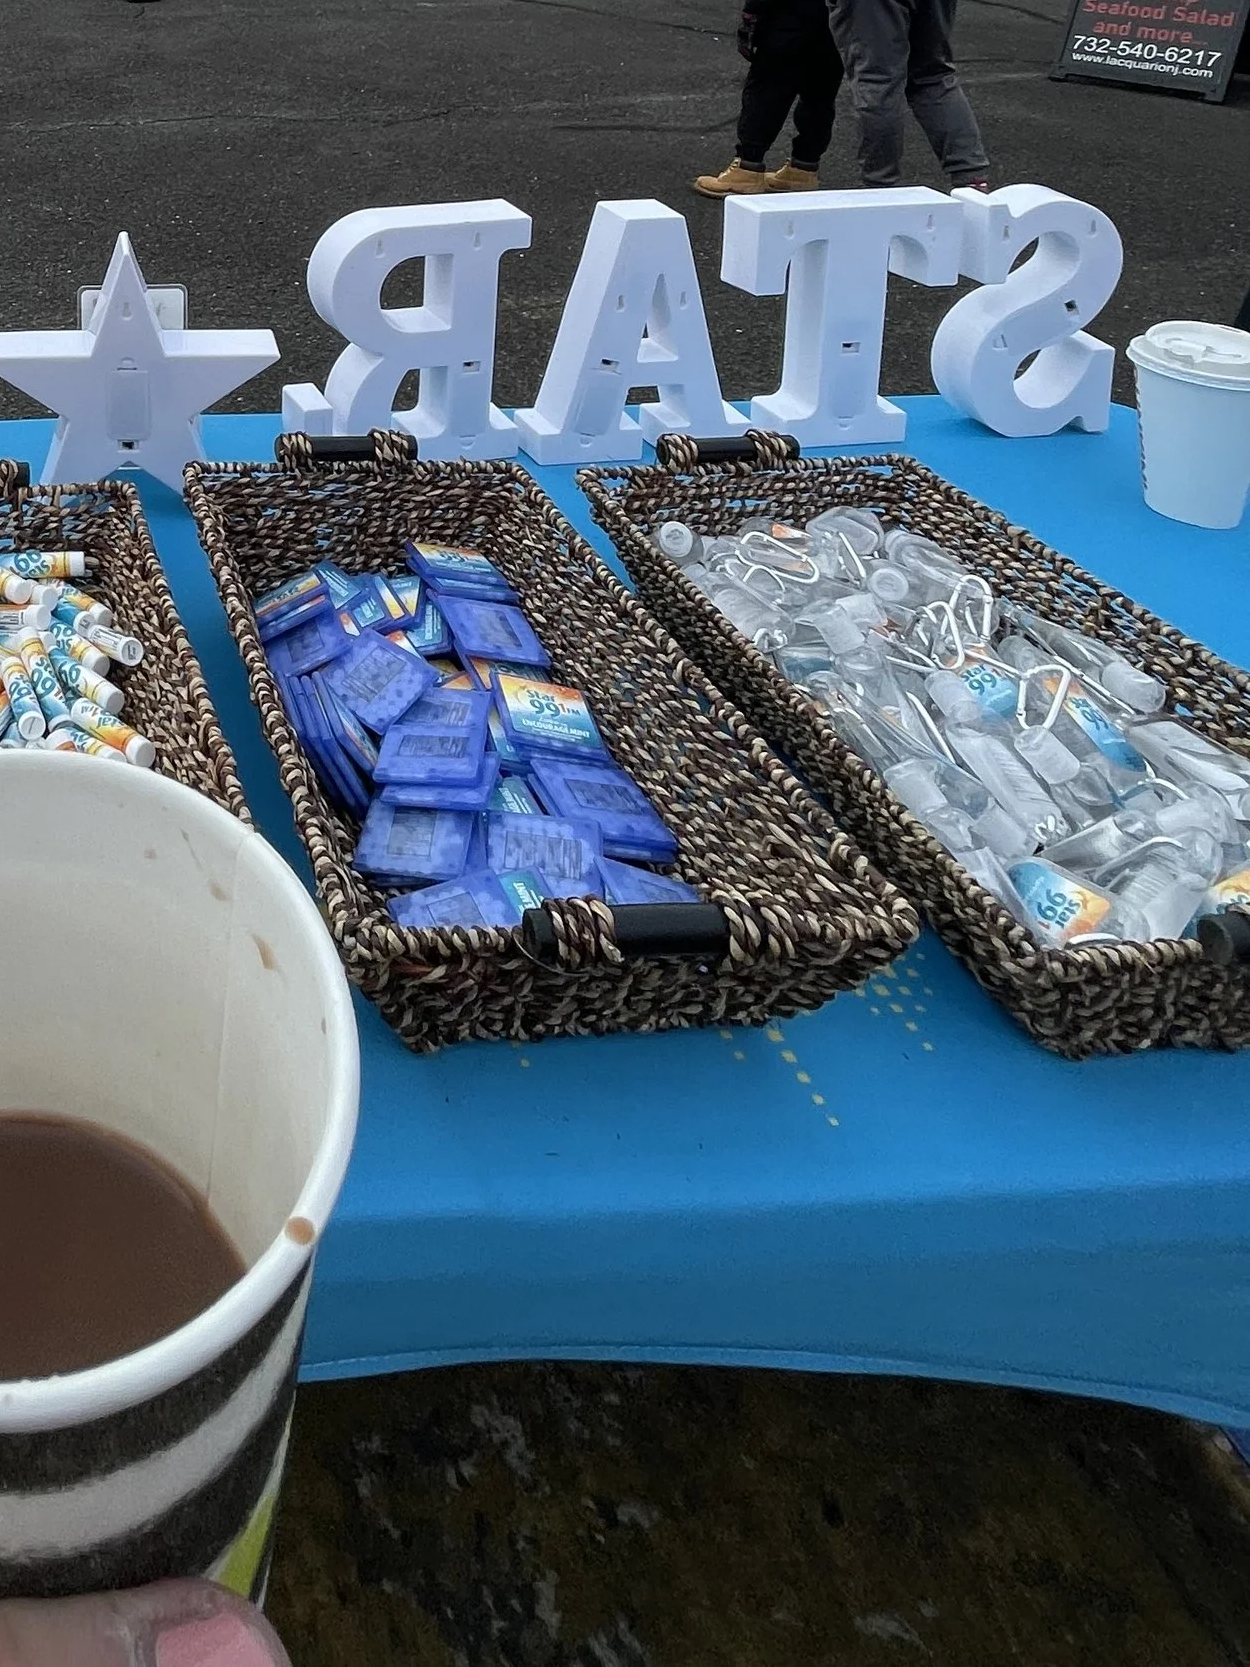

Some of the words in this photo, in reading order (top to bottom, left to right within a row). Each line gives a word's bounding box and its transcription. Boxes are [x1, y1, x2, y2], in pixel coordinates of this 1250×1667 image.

[1092, 20, 1132, 36] and
[1172, 6, 1236, 27] Salad
[1073, 35, 1222, 68] 732-540-6217
[1072, 51, 1213, 78] www.lacquarionj.com
